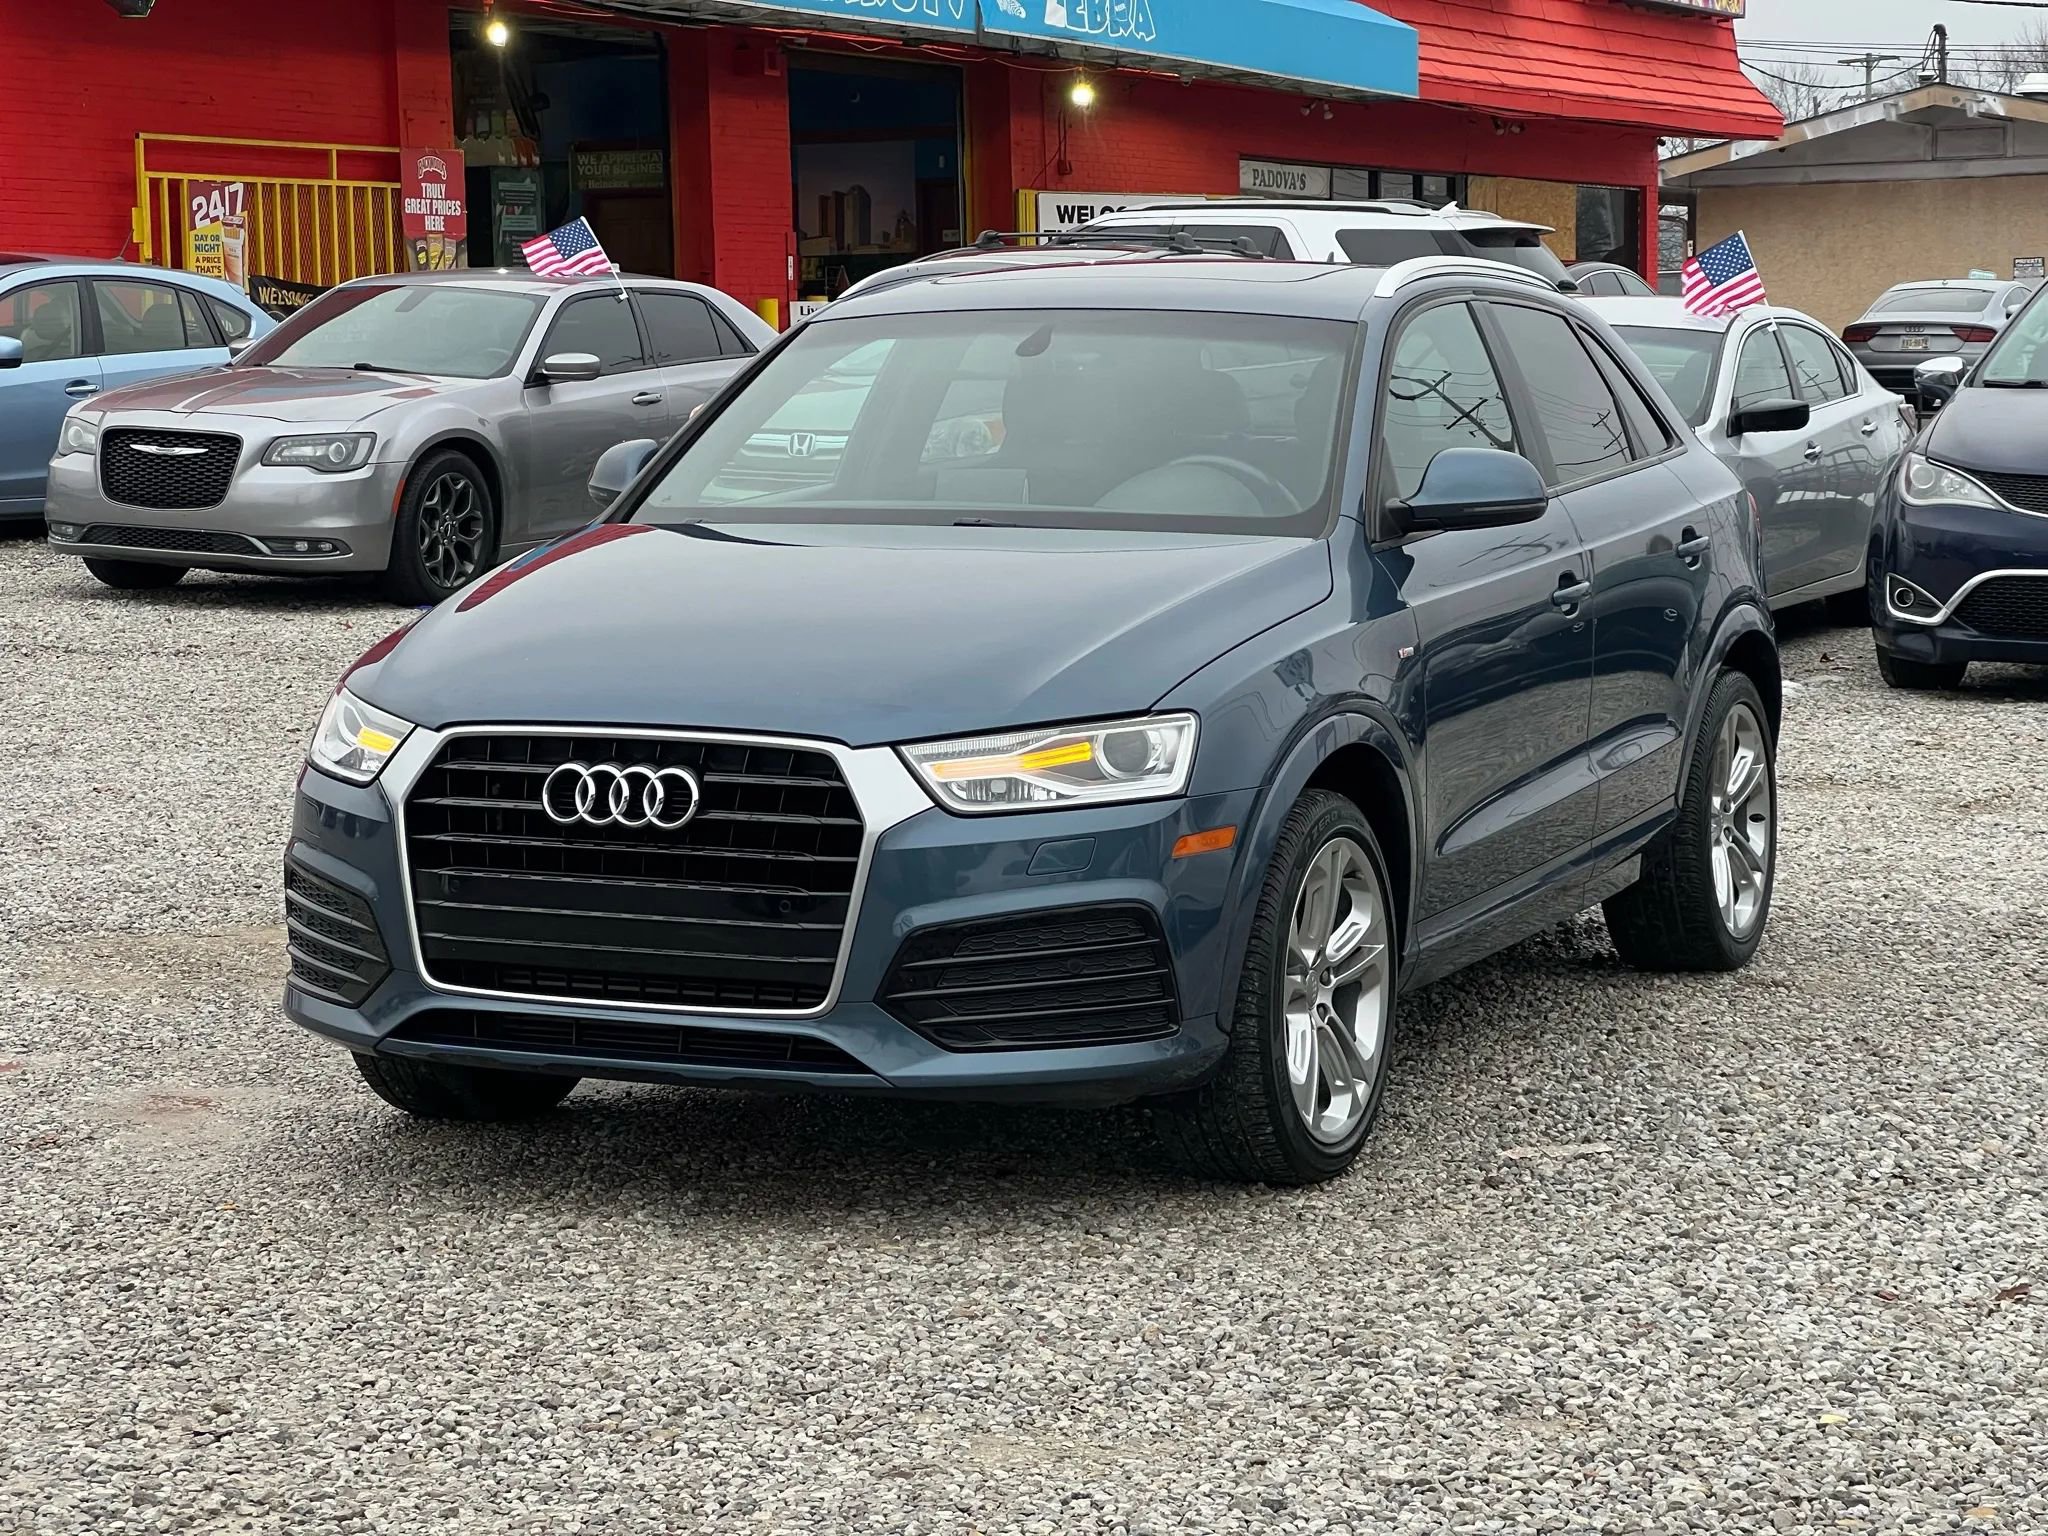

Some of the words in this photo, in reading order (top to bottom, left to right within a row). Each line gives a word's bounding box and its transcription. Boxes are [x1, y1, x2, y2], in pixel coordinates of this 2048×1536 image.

[577, 154, 597, 165] WE
[577, 164, 610, 176] YOUR
[1252, 168, 1307, 191] PADOVA'S
[421, 182, 446, 199] TRULY
[404, 198, 431, 214] GREAT
[432, 199, 461, 216] PRICES
[424, 215, 445, 231] HERE
[194, 234, 208, 242] DAY
[209, 234, 220, 242] OR
[194, 243, 220, 253] NIGHT
[195, 256, 201, 264] A
[202, 256, 222, 264] PRICE
[195, 265, 222, 274] THAT'S
